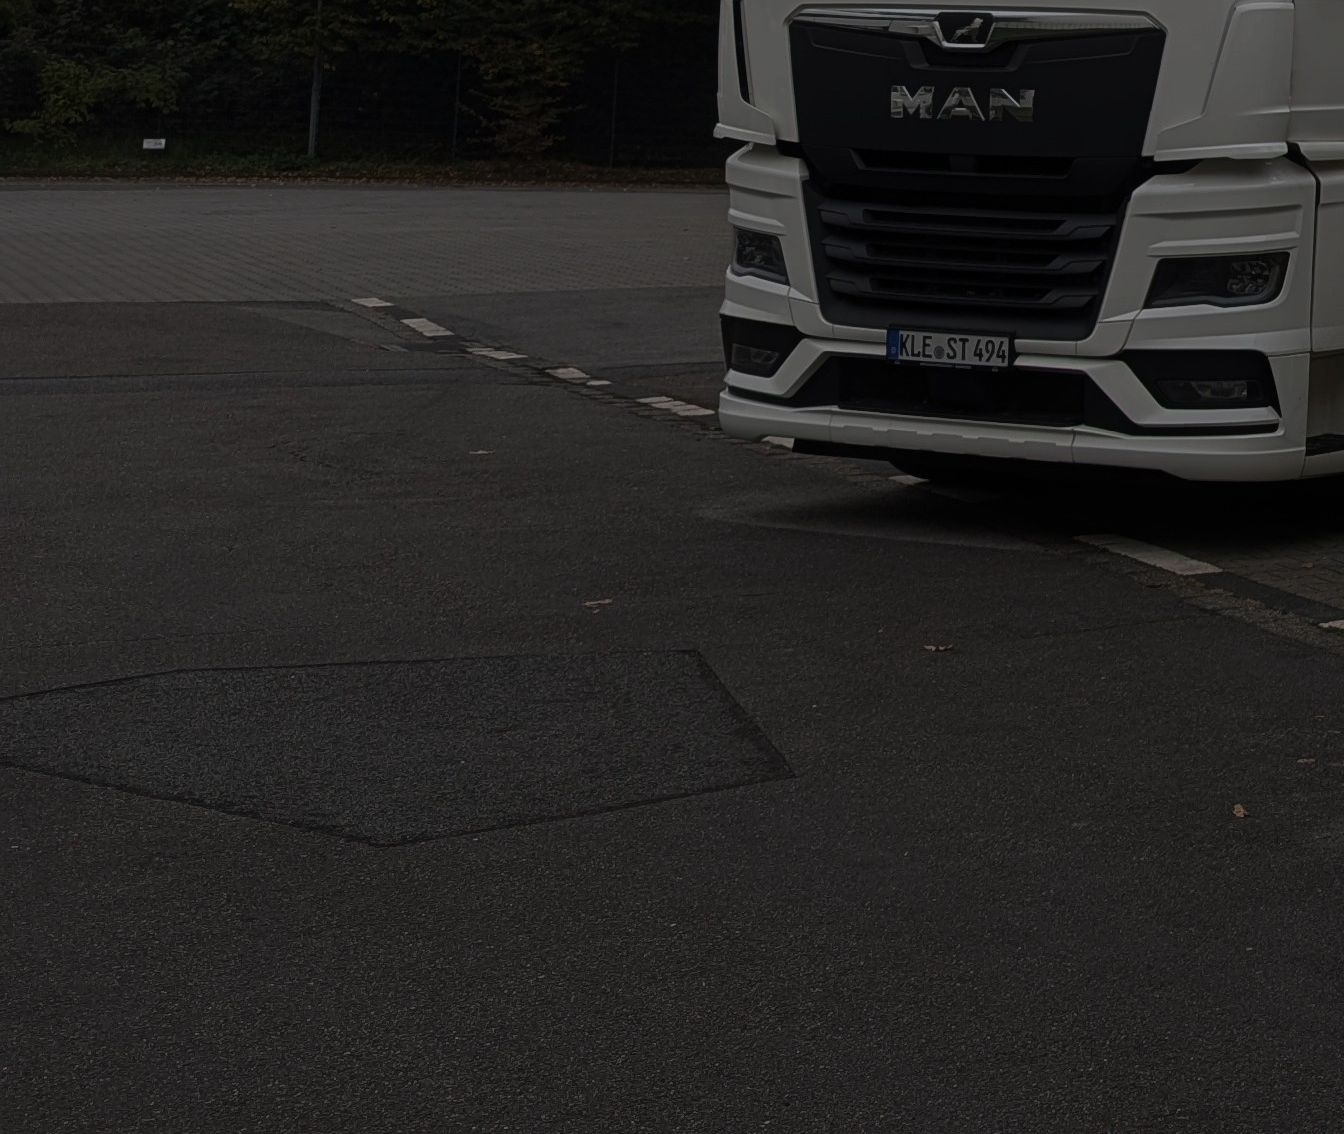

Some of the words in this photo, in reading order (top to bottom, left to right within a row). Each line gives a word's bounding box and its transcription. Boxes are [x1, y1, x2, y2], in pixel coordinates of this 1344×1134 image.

[890, 84, 1036, 123] MAN
[900, 334, 933, 358] KLE
[946, 337, 970, 361] ST
[973, 338, 1007, 364] 494
